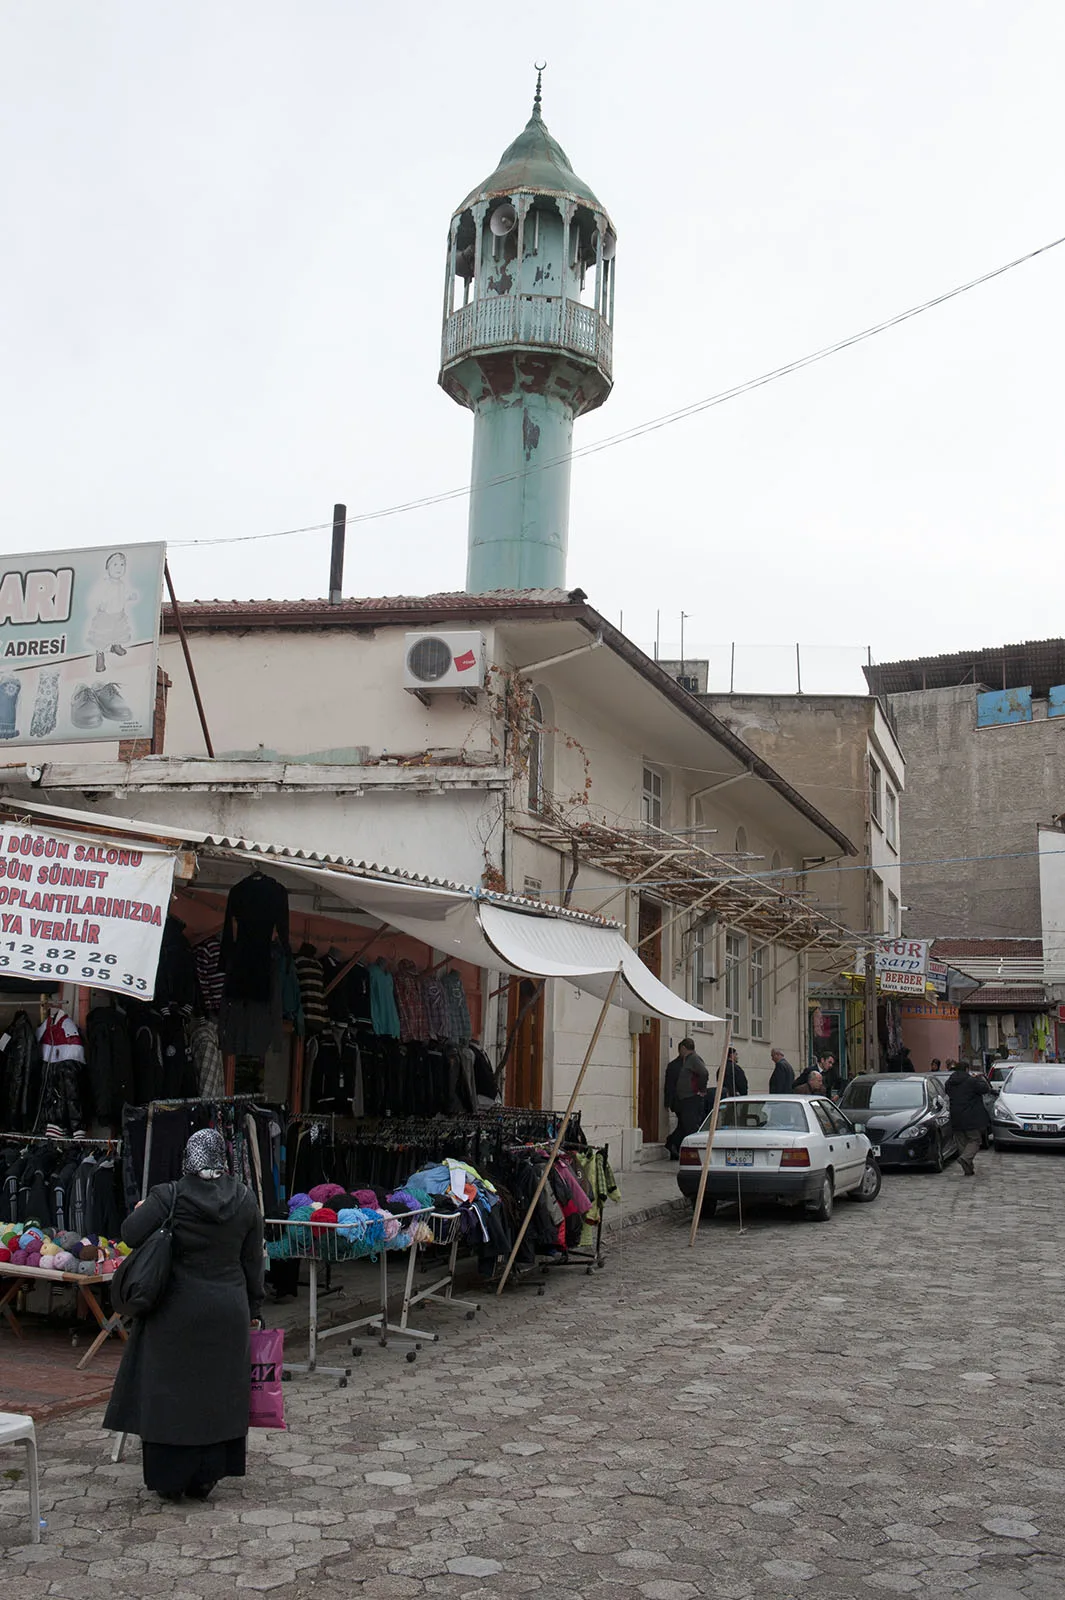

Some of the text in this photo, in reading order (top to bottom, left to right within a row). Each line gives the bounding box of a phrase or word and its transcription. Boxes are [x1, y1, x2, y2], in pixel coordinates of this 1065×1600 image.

[5, 635, 66, 657] ADRESİ
[8, 834, 70, 859] DÜĞÜN
[74, 845, 143, 867] SALONU
[37, 863, 109, 889] SÜNNET
[1, 913, 101, 944] YA VERİLİR
[46, 948, 77, 960] 82
[88, 952, 118, 965] 26
[22, 960, 69, 975] 280
[81, 967, 111, 980] 95
[122, 973, 148, 991] 33
[885, 972, 923, 986] BERBER
